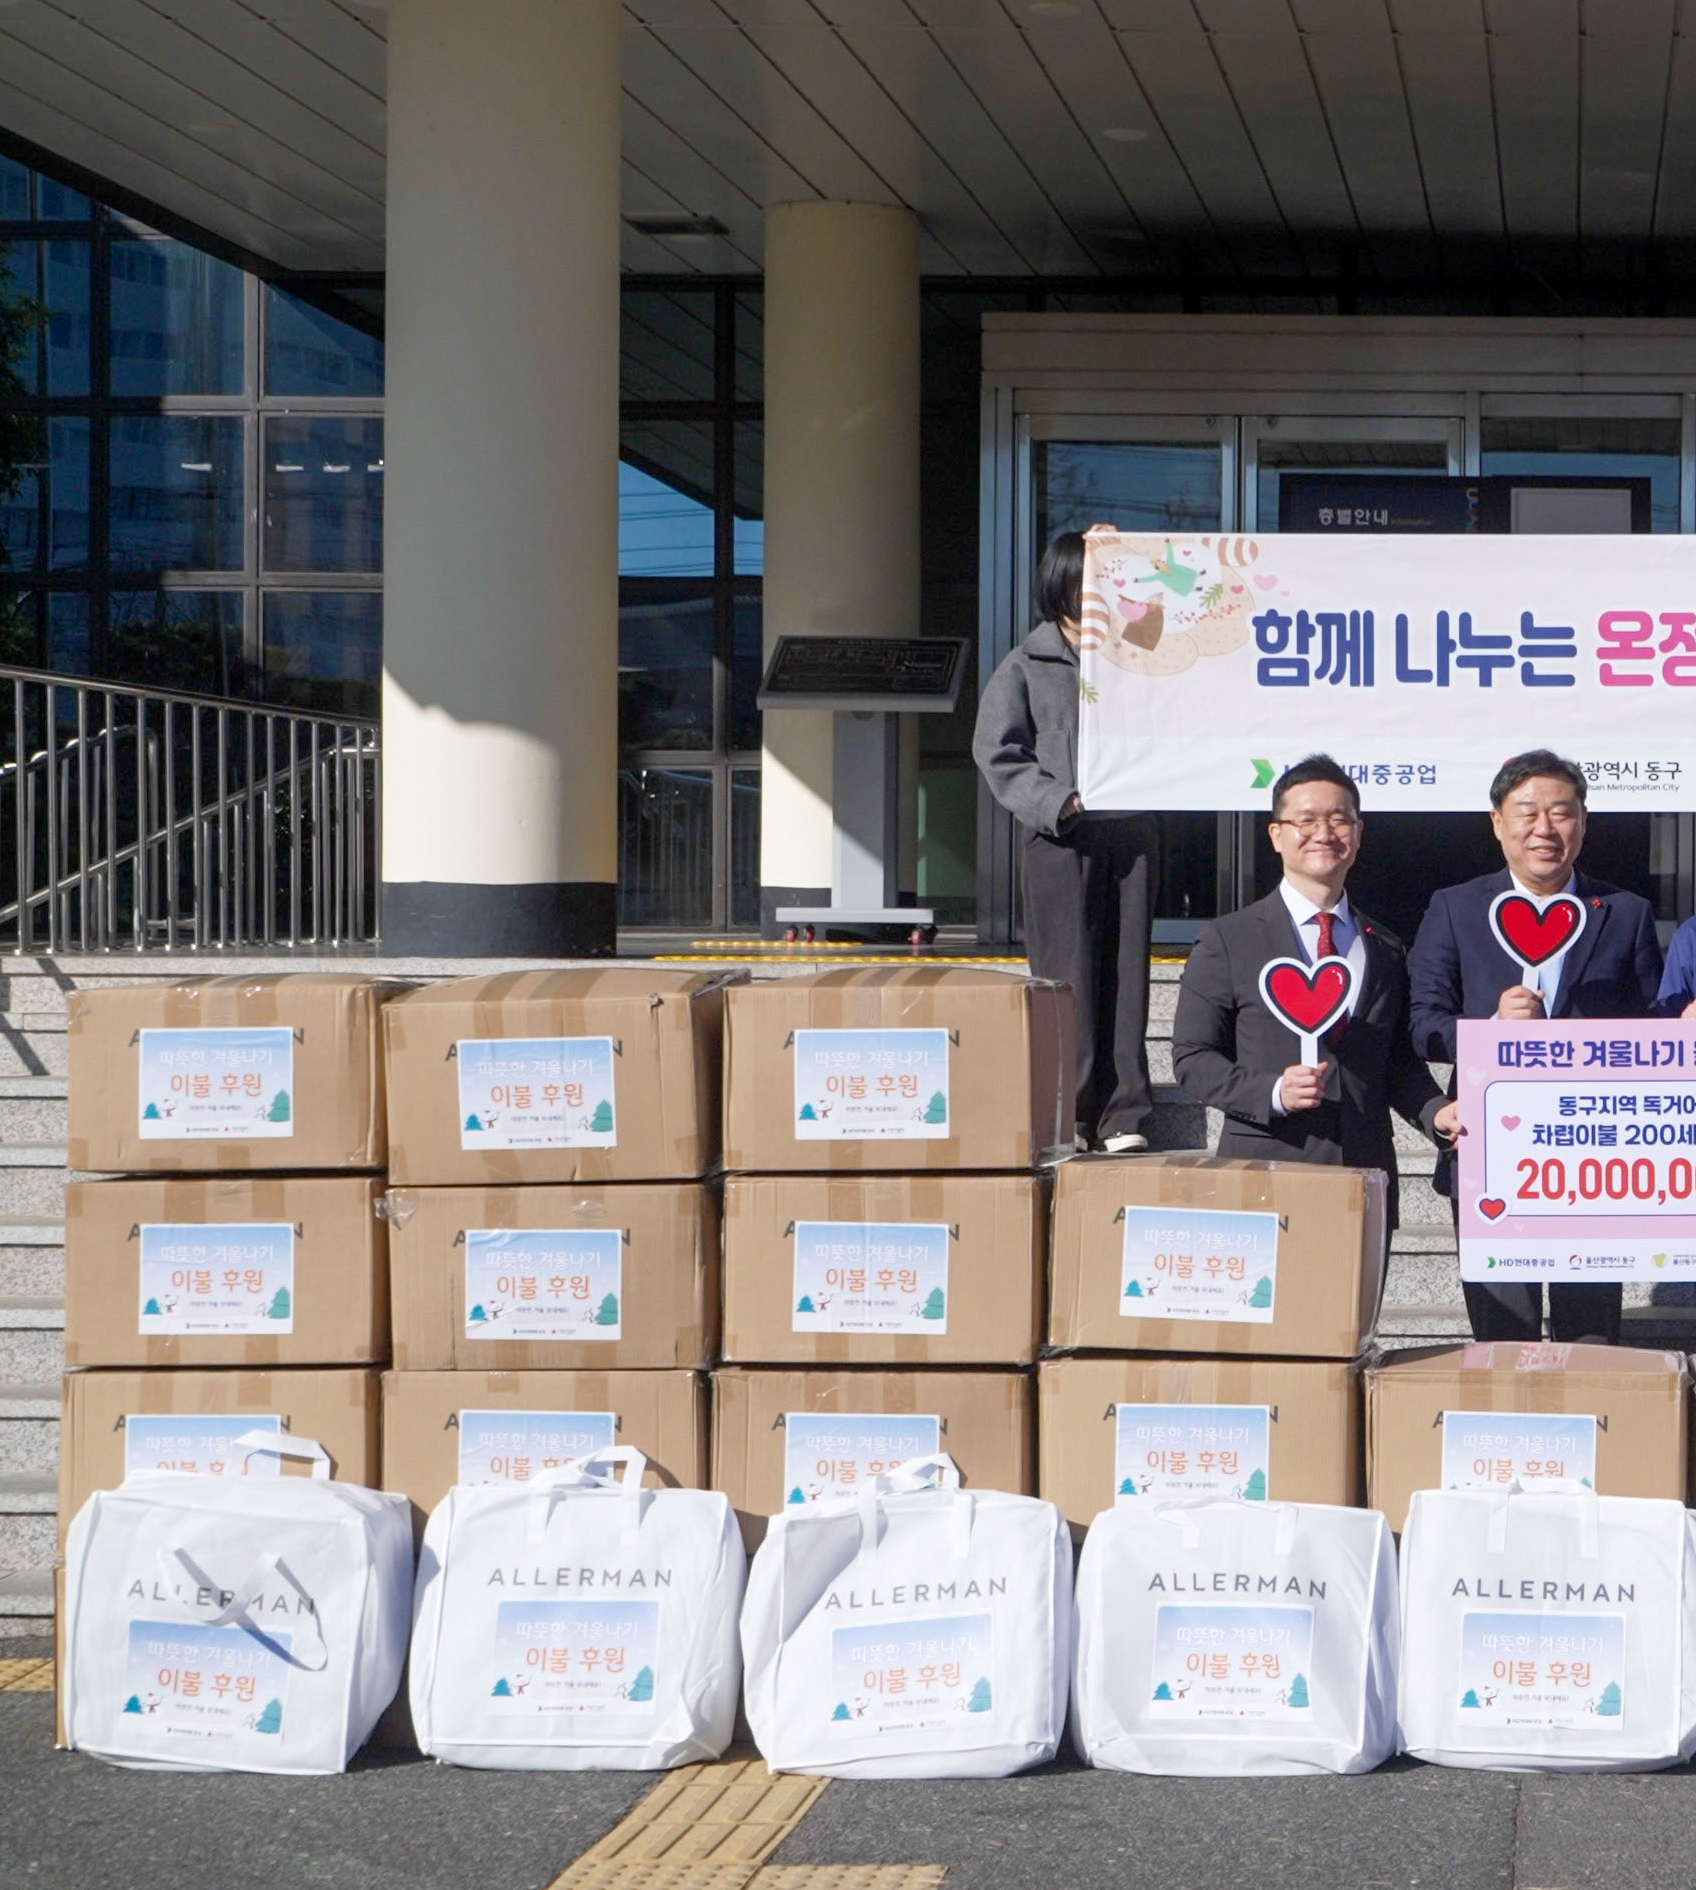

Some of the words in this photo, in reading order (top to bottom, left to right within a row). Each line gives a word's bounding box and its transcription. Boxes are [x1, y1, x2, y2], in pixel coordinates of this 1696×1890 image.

[1318, 508, 1388, 526] 층별안내
[1252, 609, 1374, 690] 함께
[1397, 610, 1578, 688] 나누는
[1577, 761, 1637, 781] 광역시
[1644, 761, 1682, 781] 동구
[1607, 783, 1660, 792] Metropolitan
[1662, 783, 1680, 792] City
[814, 1051, 861, 1069] 따뜻한
[868, 1050, 928, 1068] 겨울나기
[1498, 1040, 1575, 1067] 따뜻한
[1583, 1040, 1684, 1067] 겨울나기
[478, 1060, 525, 1080] 따뜻한
[532, 1058, 593, 1078] 겨울나기
[490, 1084, 533, 1109] 이불
[540, 1082, 583, 1107] 후원
[826, 1074, 867, 1099] 이불
[876, 1074, 918, 1098] 후원
[1559, 1096, 1637, 1116] 동구지역
[1532, 1124, 1618, 1146] 차렵이불
[1144, 1228, 1191, 1248] 따뜻한
[1197, 1231, 1258, 1251] 겨울나기
[160, 1245, 207, 1264] 따뜻한
[214, 1245, 274, 1263] 겨울나기
[814, 1243, 861, 1262] 따뜻한
[868, 1244, 928, 1263] 겨울나기
[1499, 1258, 1555, 1268] HD현대중공업
[1622, 1256, 1636, 1265] 동구
[1153, 1252, 1196, 1279] 이불
[1203, 1255, 1246, 1281] 후원
[171, 1269, 213, 1293] 이불
[221, 1269, 263, 1293] 후원
[825, 1267, 867, 1292] 이불
[875, 1268, 917, 1293] 후원
[479, 1432, 526, 1450] 따뜻한
[533, 1433, 593, 1450] 겨울나기
[805, 1435, 852, 1453] 따뜻한
[859, 1436, 919, 1453] 겨울나기
[1135, 1426, 1182, 1444] 따뜻한
[1189, 1426, 1249, 1445] 겨울나기
[1462, 1433, 1509, 1452] 따뜻한
[1516, 1435, 1576, 1454] 겨울나기
[490, 1455, 532, 1479] 이불
[816, 1458, 858, 1482] 이불
[1146, 1450, 1188, 1474] 이불
[1196, 1450, 1238, 1475] 후원
[1473, 1457, 1515, 1482] 이불
[487, 1568, 672, 1588] ALLERMAN
[1148, 1573, 1327, 1600] ALLERMAN
[825, 1577, 1007, 1611] ALLERMAN
[1451, 1578, 1636, 1603] ALLERMAN
[515, 1621, 566, 1641] 따뜻한
[573, 1621, 639, 1640] 겨울나기
[1175, 1626, 1225, 1646] 따뜻한
[1232, 1627, 1294, 1648] 겨울나기
[149, 1640, 200, 1664] 따뜻한
[205, 1646, 271, 1671] 겨울나기
[851, 1642, 901, 1666] 따뜻한
[909, 1635, 973, 1660] 겨울나기
[1481, 1634, 1532, 1654] 따뜻한
[1539, 1635, 1604, 1655] 겨울나기
[524, 1647, 571, 1673] 이불
[578, 1647, 625, 1672] 후원
[1185, 1651, 1230, 1678] 이불
[1237, 1653, 1282, 1679] 후원
[156, 1667, 203, 1697] 이불
[208, 1672, 256, 1702] 후원
[862, 1666, 907, 1696] 이불
[916, 1661, 961, 1690] 후원
[1492, 1659, 1537, 1686] 이불
[1545, 1660, 1592, 1687] 후원
